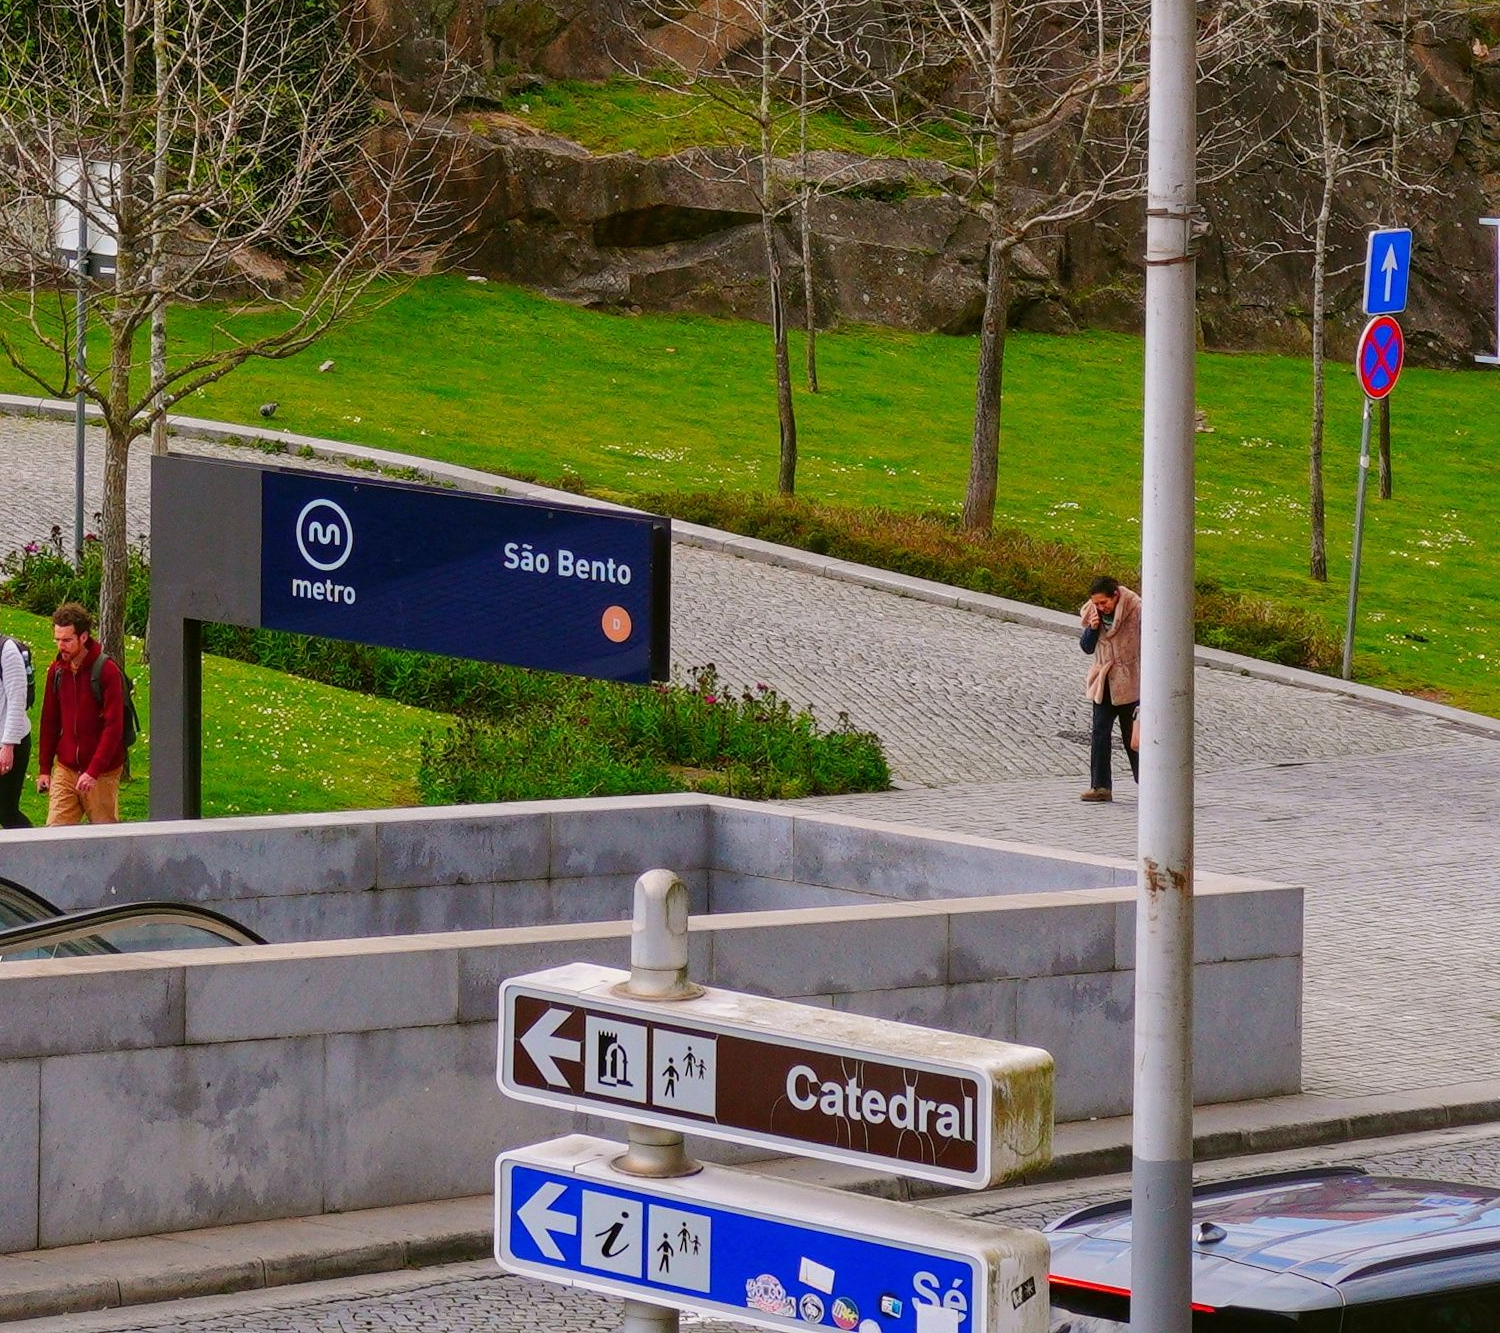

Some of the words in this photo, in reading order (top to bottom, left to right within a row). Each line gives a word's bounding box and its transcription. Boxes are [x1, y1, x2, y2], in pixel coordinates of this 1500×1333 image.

[503, 541, 550, 575] São
[557, 549, 632, 586] Bento
[291, 577, 357, 605] metro
[786, 1064, 973, 1142] Catedral
[911, 1270, 968, 1323] Sé
